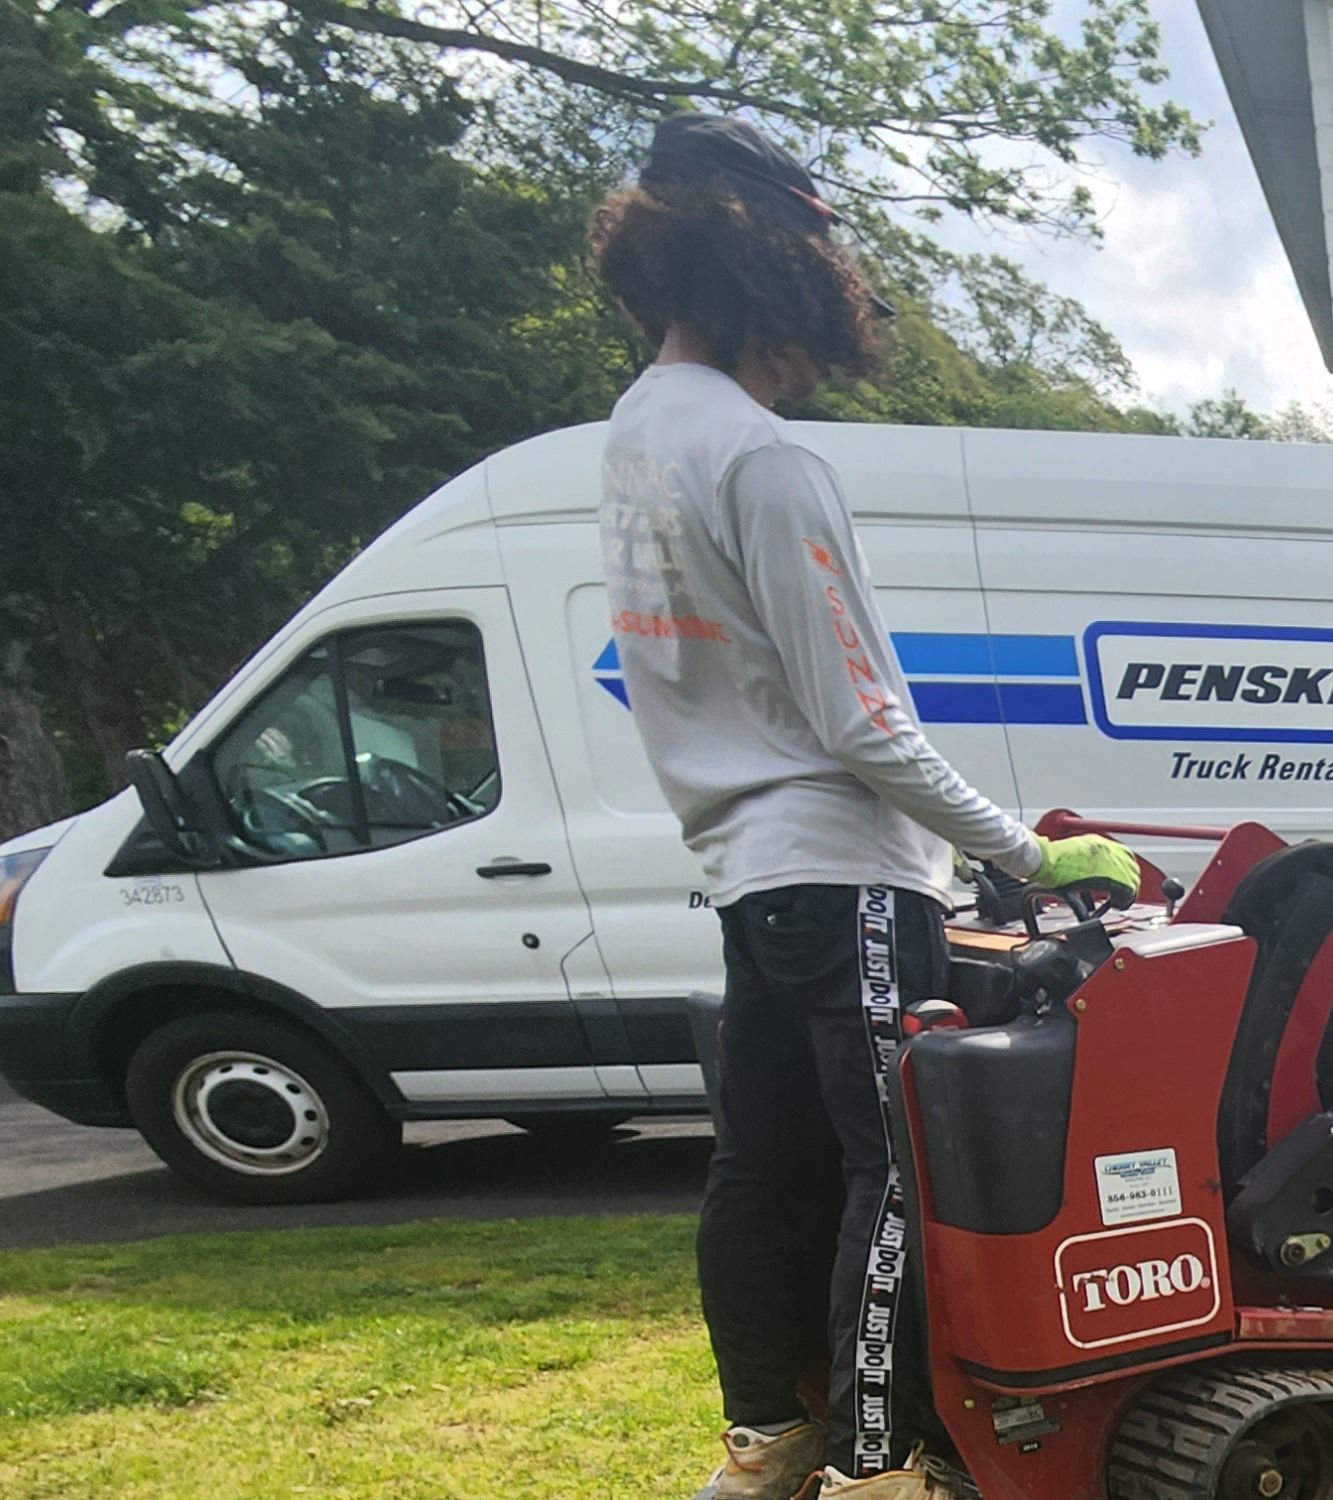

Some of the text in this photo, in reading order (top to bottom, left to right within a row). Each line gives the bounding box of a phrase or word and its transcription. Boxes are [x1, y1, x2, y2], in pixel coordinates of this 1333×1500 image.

[1170, 752, 1252, 780] Truck
[865, 938, 891, 981] JUST
[869, 981, 892, 1005] DO
[880, 1211, 906, 1249] JUST
[875, 1248, 899, 1274] DO
[1072, 1254, 1204, 1312] TORO
[864, 1302, 892, 1342] JUST
[863, 1342, 886, 1367] DO
[862, 1393, 885, 1431] JUST
